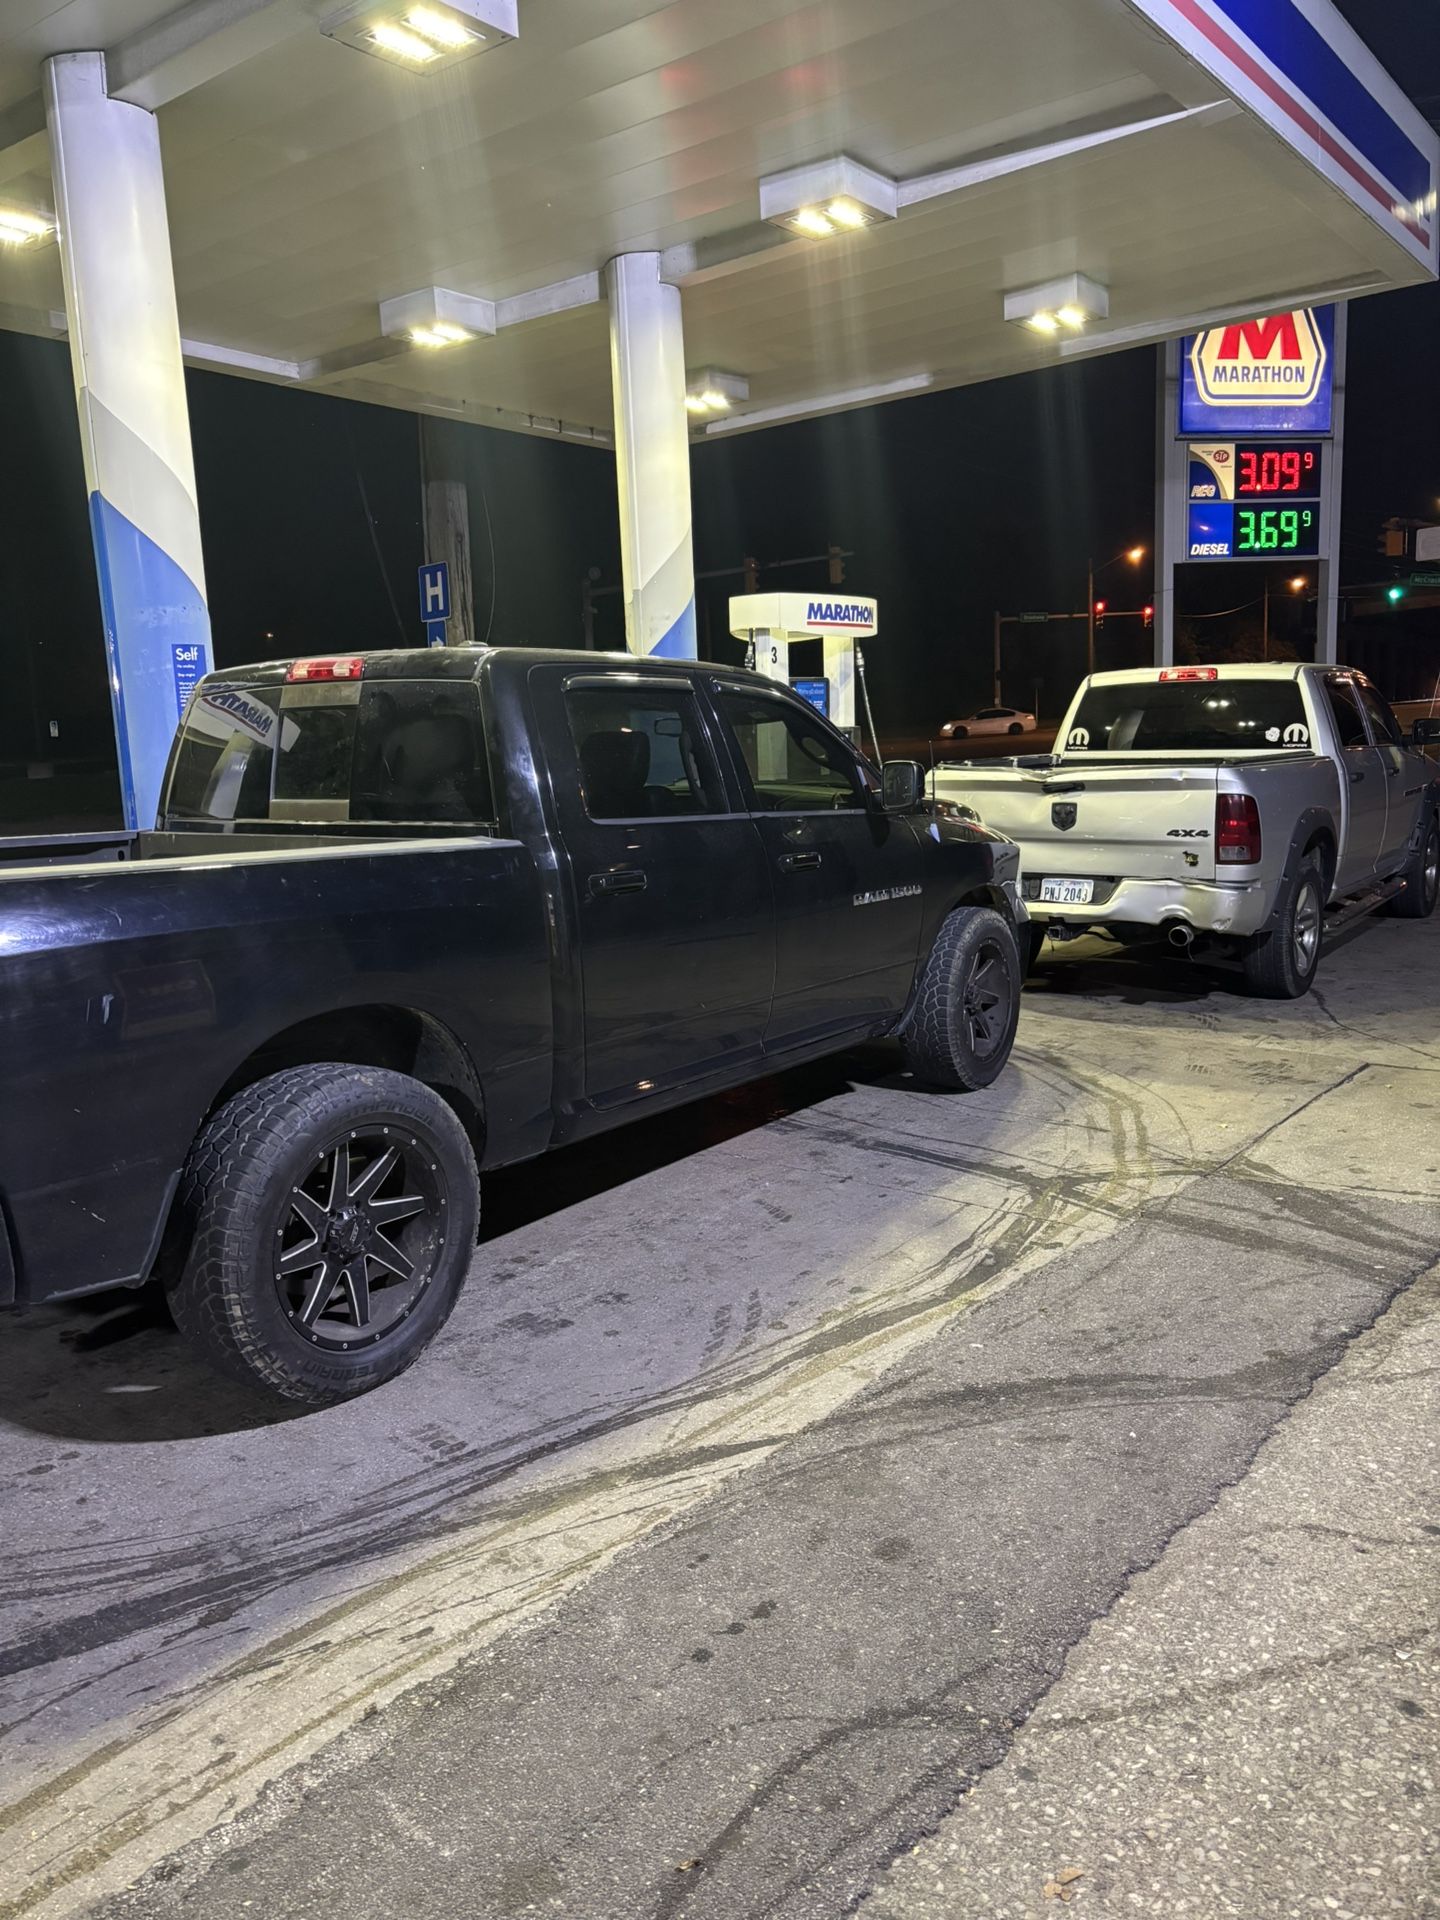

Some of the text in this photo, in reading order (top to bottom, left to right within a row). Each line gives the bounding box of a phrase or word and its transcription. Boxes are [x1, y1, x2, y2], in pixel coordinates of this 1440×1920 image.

[1212, 366, 1305, 382] MARATHON
[1239, 452, 1300, 491] 3.09
[1190, 485, 1216, 497] REG
[1238, 511, 1298, 549] 3.69
[1190, 543, 1229, 555] DIESEL
[425, 571, 444, 613] H
[807, 603, 873, 623] MARATHON
[175, 646, 198, 661] Self
[771, 646, 778, 664] 3
[1043, 886, 1089, 902] PNJ 2043
